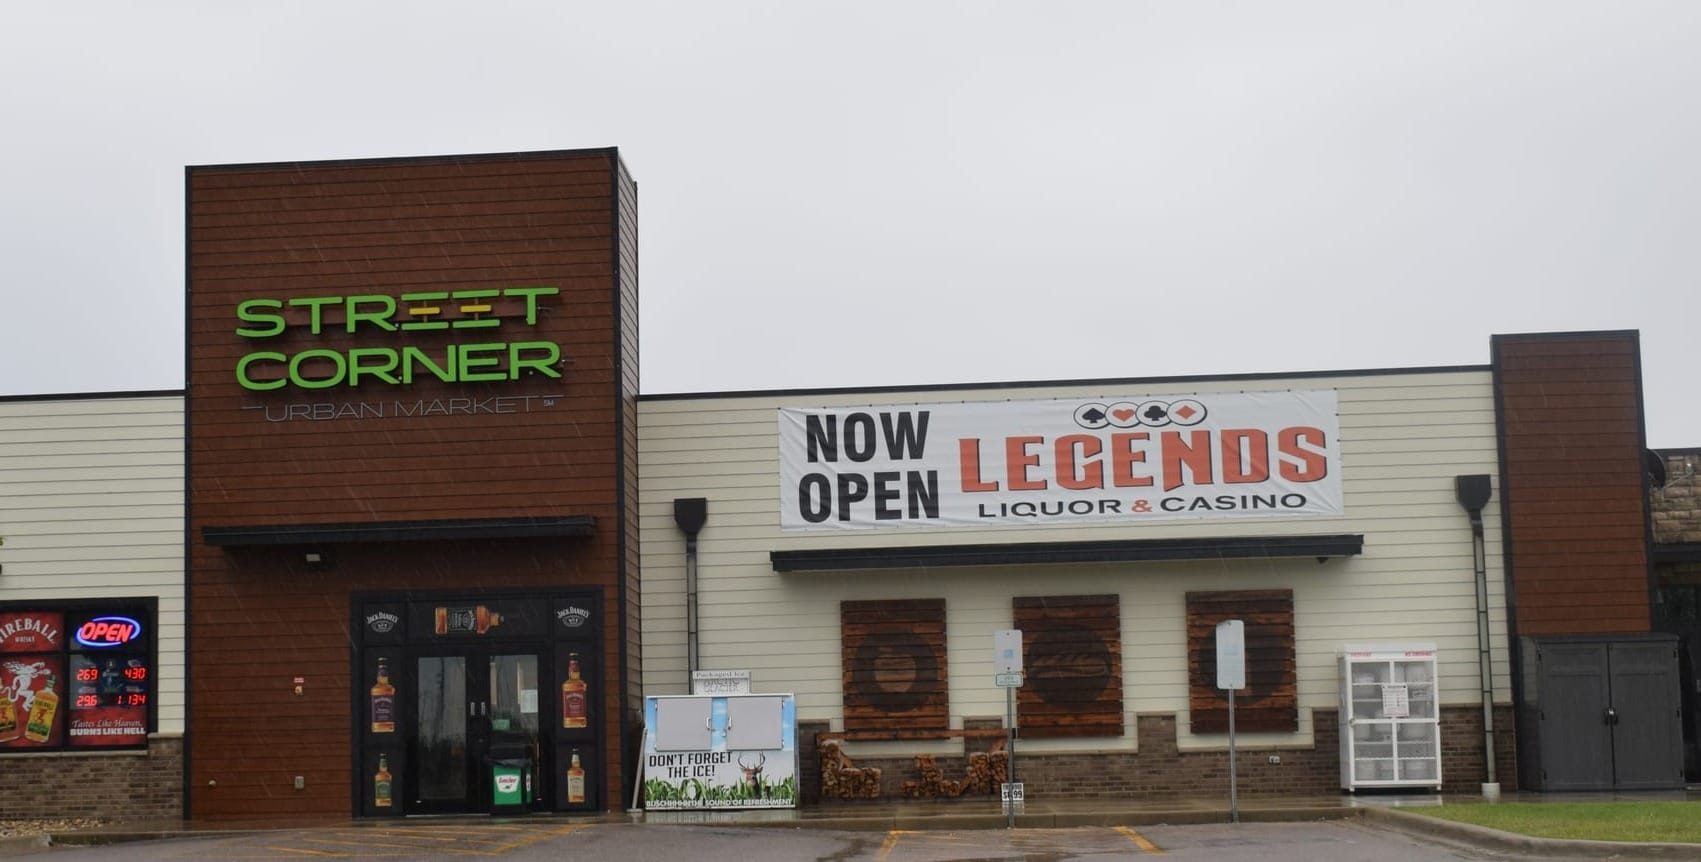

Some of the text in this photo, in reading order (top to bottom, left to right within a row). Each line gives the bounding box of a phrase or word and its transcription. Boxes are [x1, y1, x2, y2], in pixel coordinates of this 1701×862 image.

[236, 287, 559, 338] STREET
[236, 341, 562, 391] CORNER
[265, 401, 384, 422] URBAN
[394, 395, 539, 417] MARKET
[805, 410, 931, 464] NOW
[957, 425, 1328, 492] LEGENDS
[798, 469, 940, 523] OPEN
[978, 492, 1307, 518] LIQUOR & CASINO
[80, 622, 134, 643] OPEN
[76, 669, 99, 681] 269
[124, 667, 146, 680] 430
[76, 695, 98, 707] 296
[70, 727, 102, 736] BURNS
[102, 727, 123, 735] LIKE
[649, 751, 733, 767] DON'T FORGET
[668, 765, 715, 778] THE ICE!
